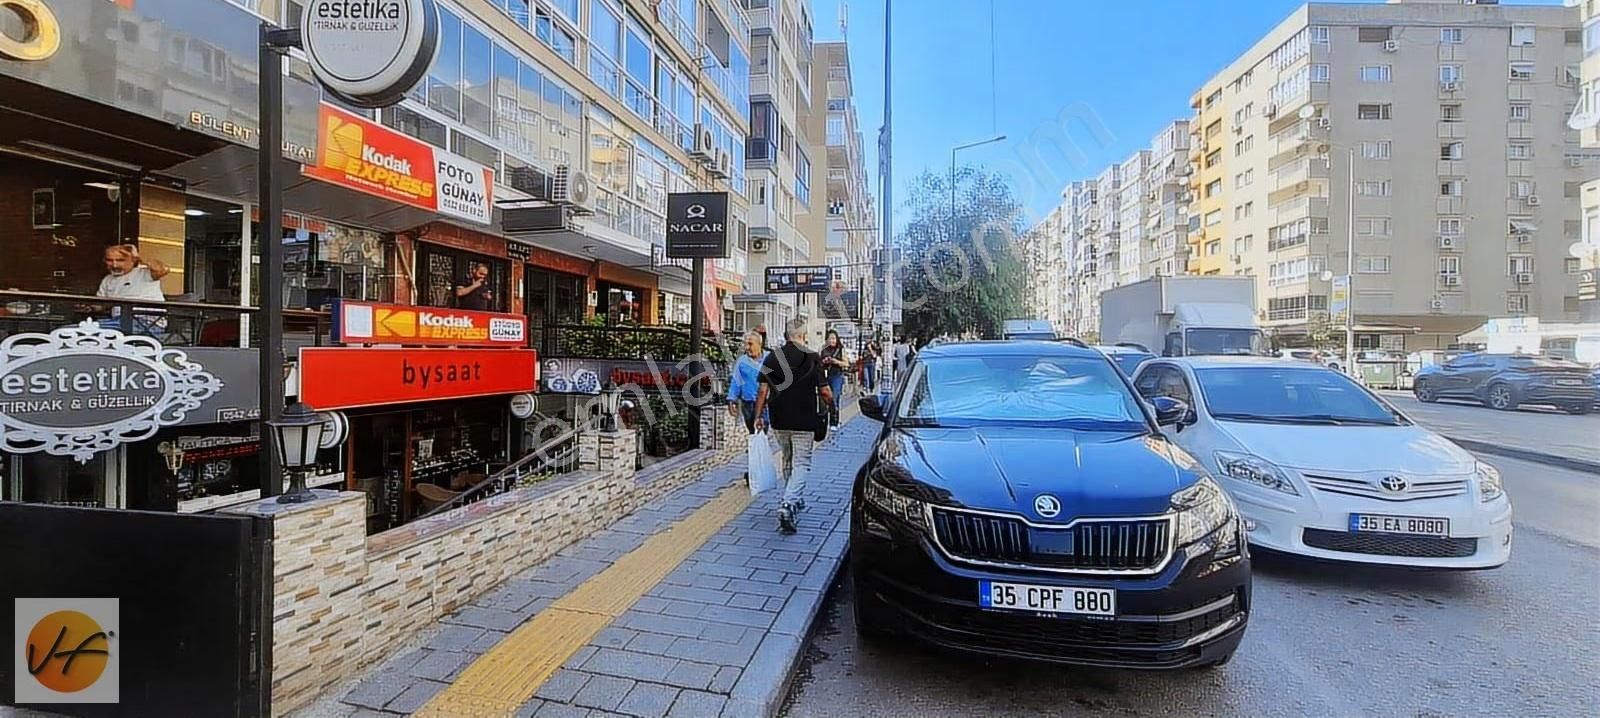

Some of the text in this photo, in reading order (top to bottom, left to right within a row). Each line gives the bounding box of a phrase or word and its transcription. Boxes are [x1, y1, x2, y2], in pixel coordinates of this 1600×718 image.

[318, 0, 400, 19] estetika
[190, 110, 252, 141] BÜLENT
[362, 143, 412, 176] Kodak
[344, 158, 434, 198] EXPRESS
[438, 161, 474, 185] FOTO
[441, 183, 484, 207] GÜNAY
[669, 223, 724, 233] NACAR
[419, 311, 474, 328] Kodak
[431, 326, 489, 341] EXPRESS
[2, 365, 161, 395] estetika
[402, 359, 481, 389] bysaat
[0, 399, 63, 414] TIRNAK
[71, 398, 82, 410] &
[1360, 516, 1378, 530] 35
[1384, 518, 1401, 531] EA
[1408, 519, 1444, 534] 8080
[992, 585, 1016, 606] 35
[1027, 587, 1063, 610] CPF
[1074, 590, 1111, 612] 880
